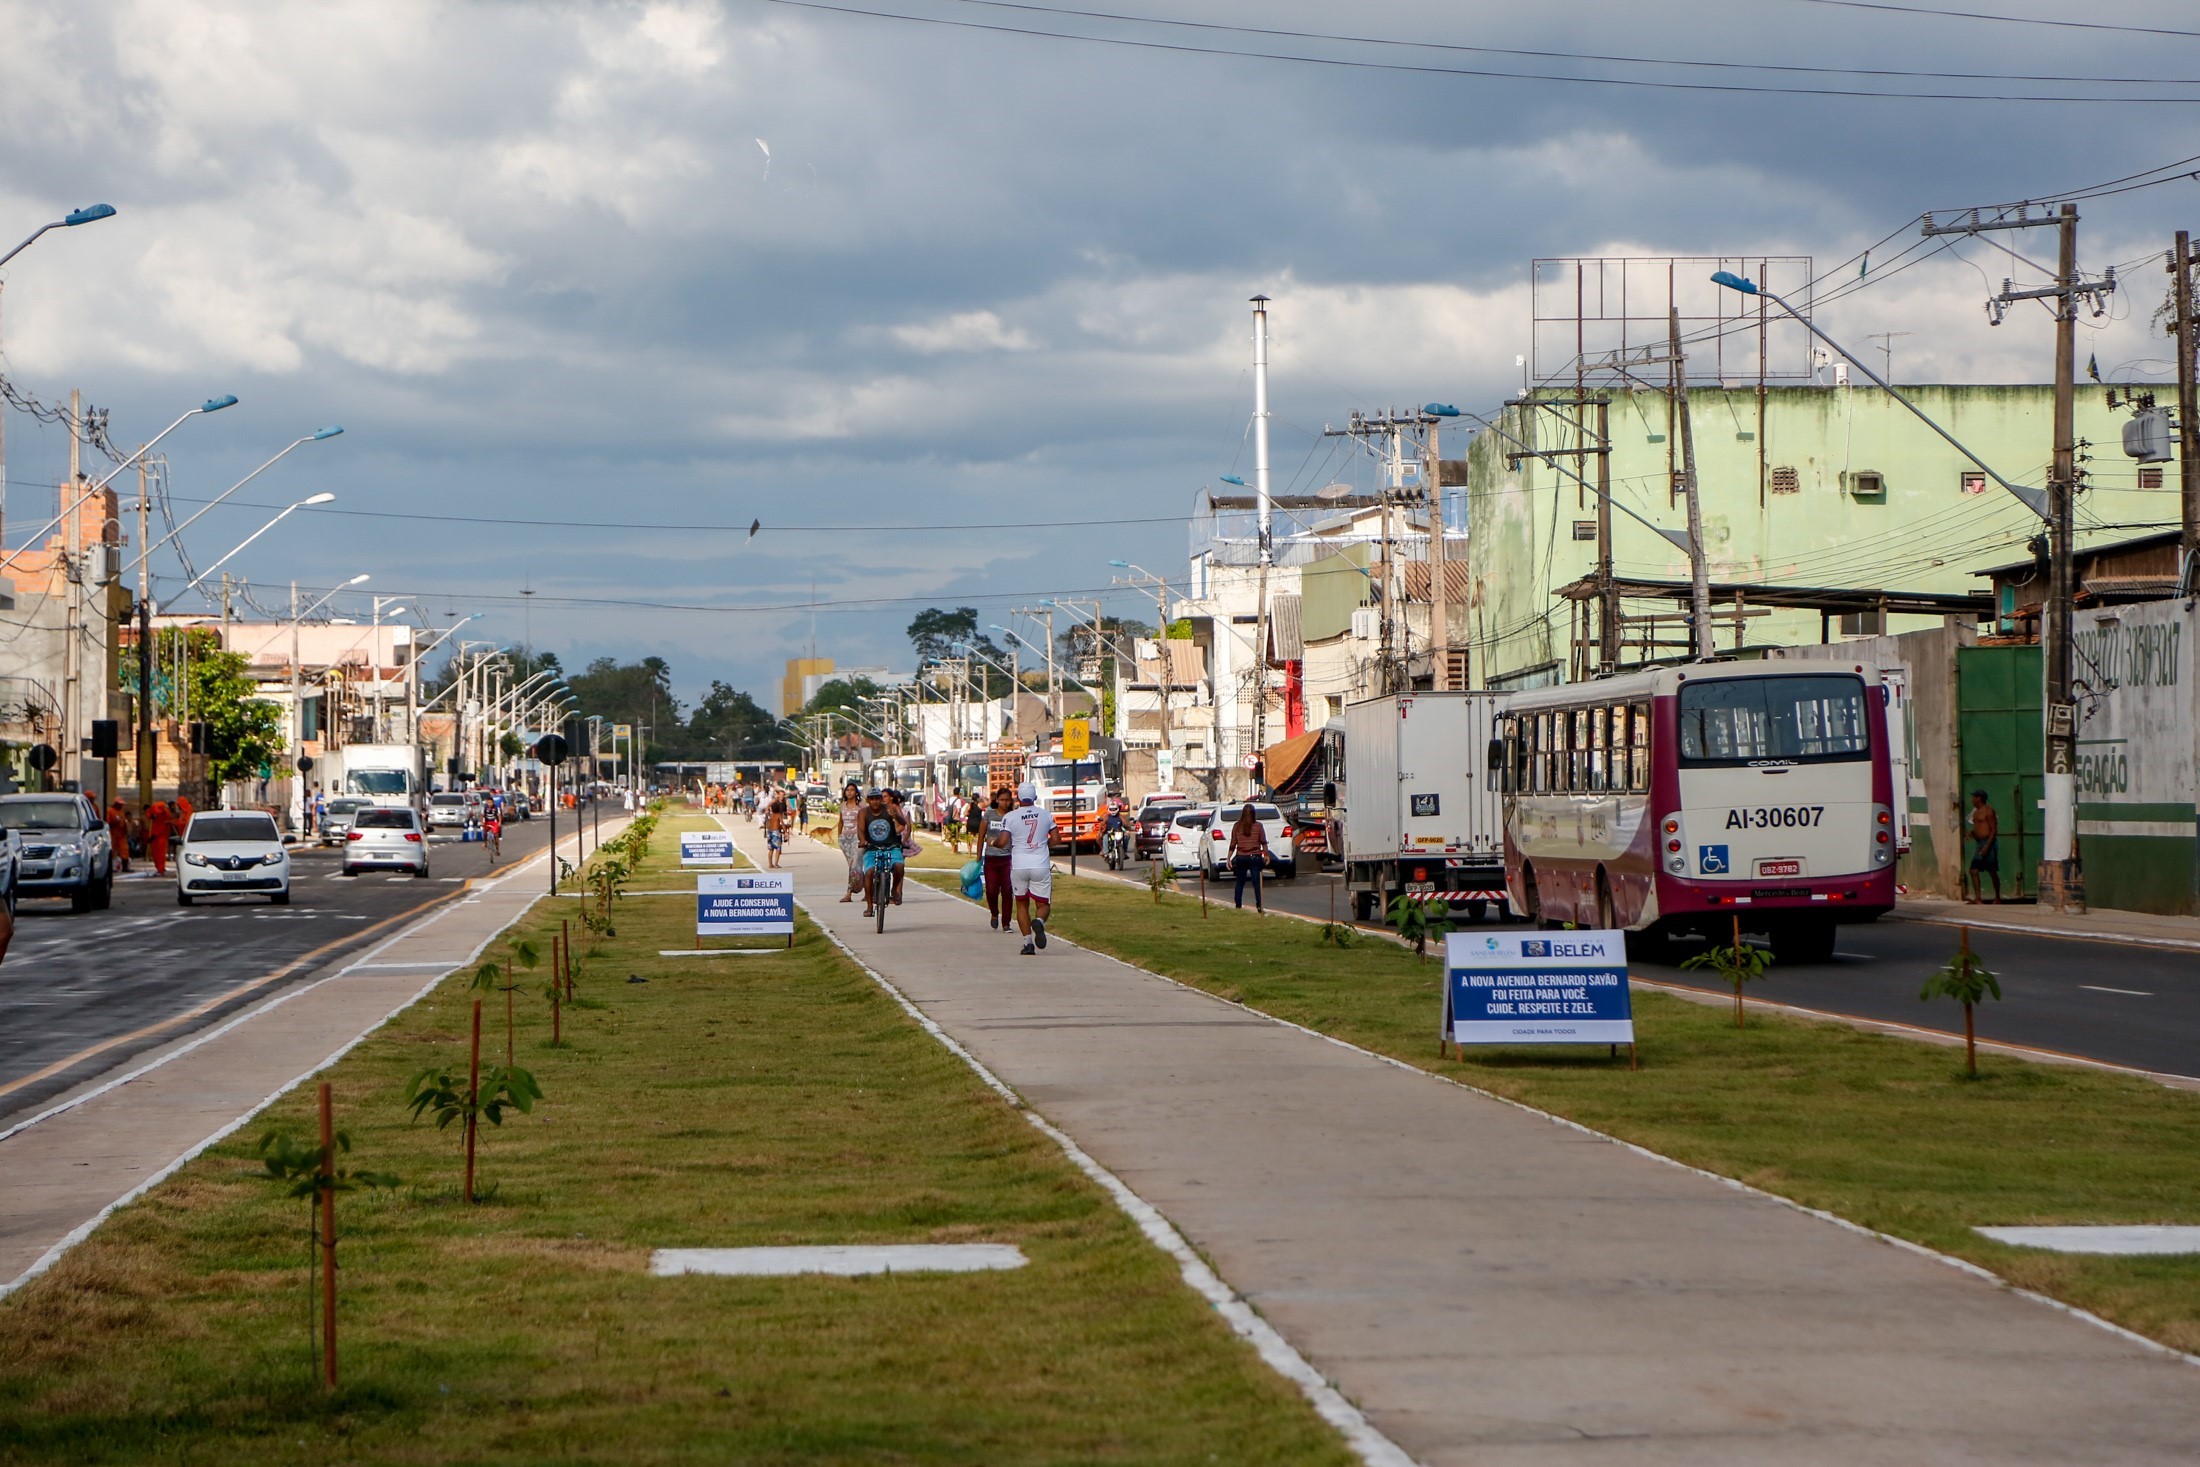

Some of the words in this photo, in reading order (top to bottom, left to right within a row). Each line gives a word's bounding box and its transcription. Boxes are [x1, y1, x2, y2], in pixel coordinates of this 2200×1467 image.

[1036, 756, 1054, 766] 250
[1725, 806, 1825, 830] AI-30607
[1024, 820, 1038, 844] 7
[712, 899, 733, 907] AJUDE
[734, 899, 740, 907] A
[740, 898, 779, 907] CONSERVAR
[704, 909, 709, 917] A
[710, 909, 728, 917] NOVA
[729, 908, 764, 917] BERNARDO
[765, 907, 788, 916] SAYÃO.
[1554, 944, 1605, 957] BELÉM
[1462, 976, 1468, 986] A
[1470, 976, 1494, 986] NOVA
[1497, 975, 1536, 986] AVENIDA
[1538, 975, 1586, 986] BERNARDO
[1588, 973, 1618, 985] SAYÃO
[1492, 989, 1507, 1000] FOI
[1509, 989, 1534, 1000] FEITA
[1536, 989, 1561, 1000] PARA
[1562, 987, 1588, 999] VOCÊ.
[1486, 1003, 1517, 1015] CUIDE,
[1519, 1003, 1561, 1014] RESPEITE
[1563, 1003, 1570, 1014] E
[1571, 1003, 1597, 1014] ZELE.
